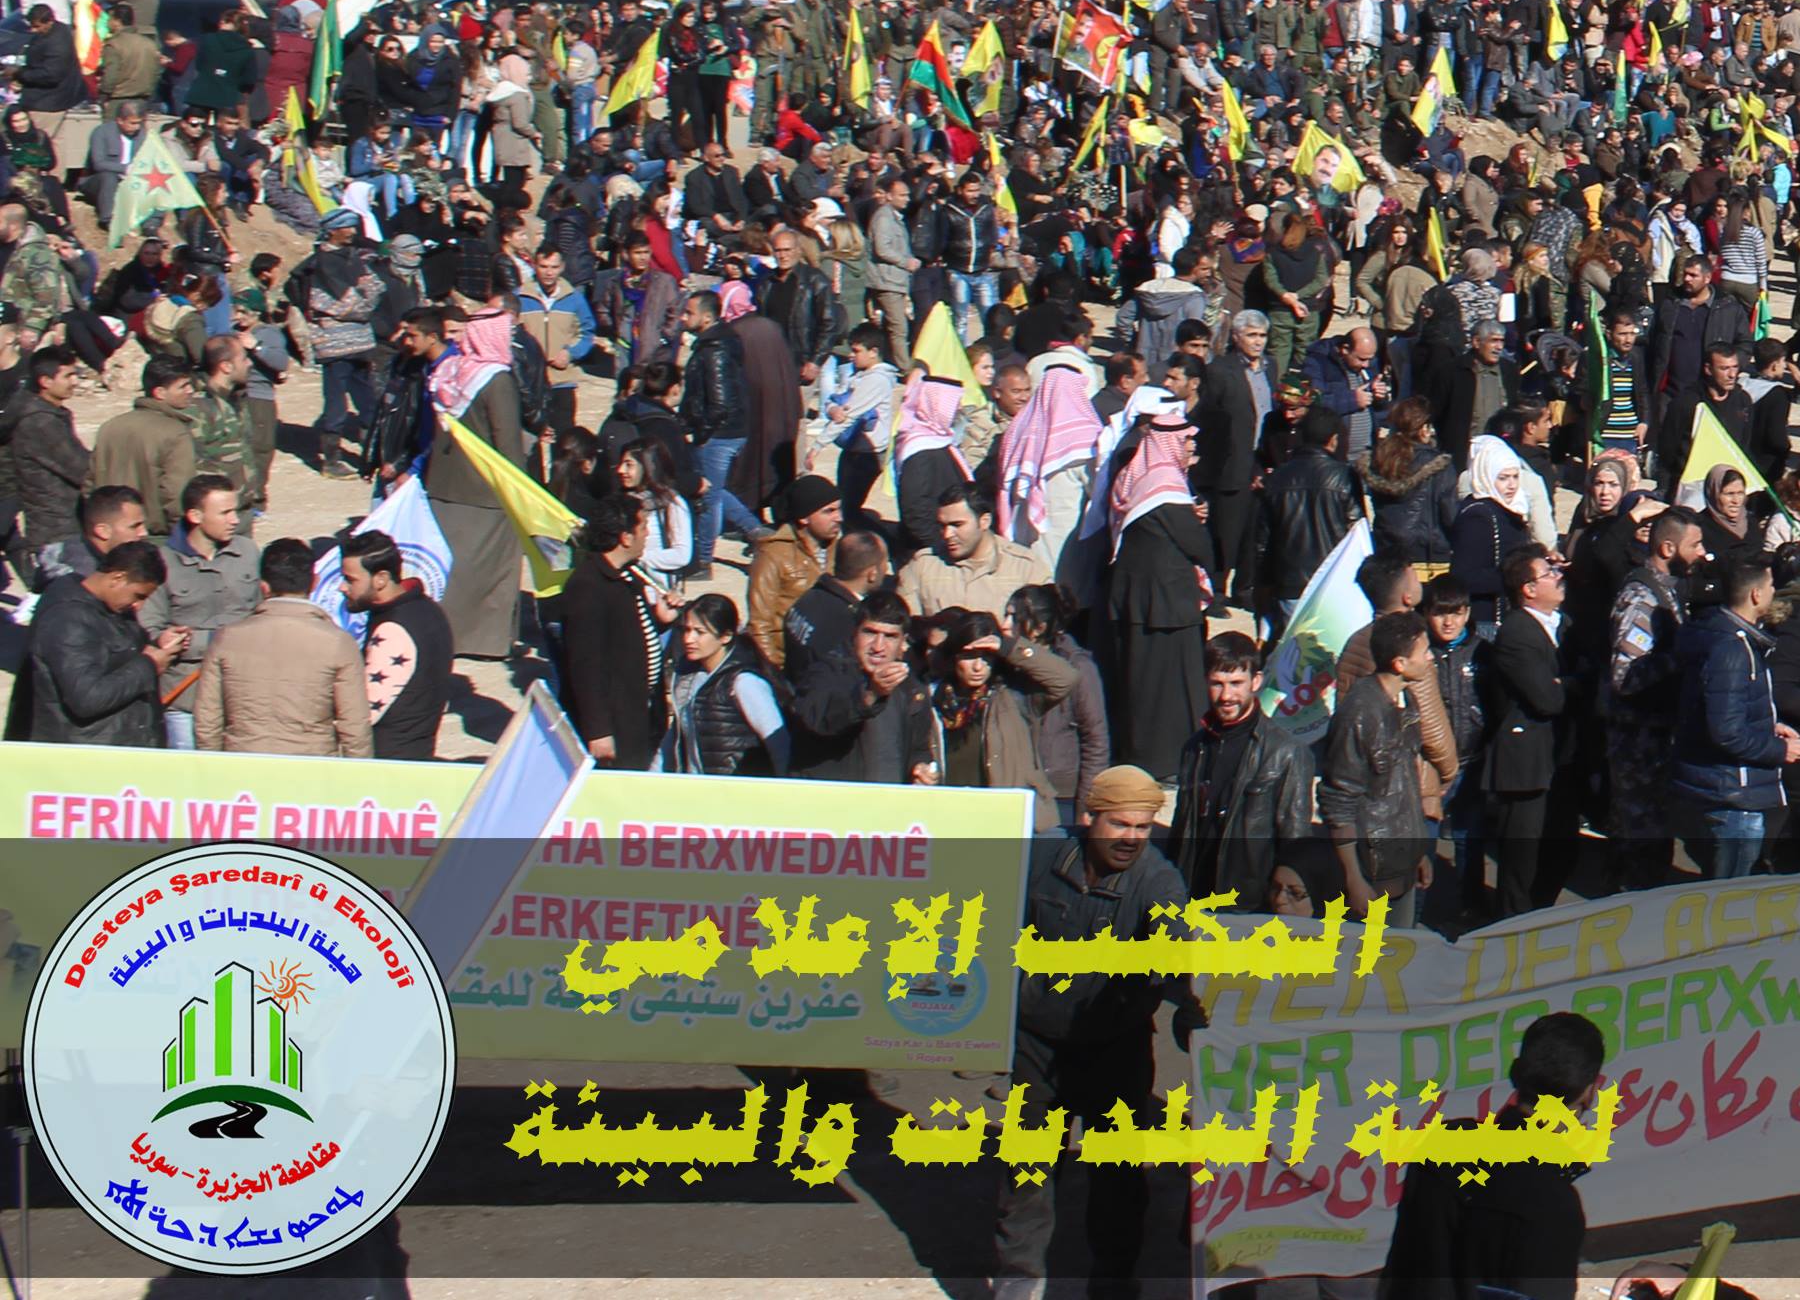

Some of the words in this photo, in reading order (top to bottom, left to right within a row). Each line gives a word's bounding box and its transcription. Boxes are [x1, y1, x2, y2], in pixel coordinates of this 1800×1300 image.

[30, 788, 171, 844] EFRÎN
[190, 794, 258, 843] WÊ
[275, 800, 438, 856] BIMÎNÊ
[620, 825, 928, 879] BERXWEDANÊ
[629, 975, 742, 1025] ستبقى
[749, 980, 861, 1030] عفرين
[1200, 1031, 1354, 1113] HER
[1643, 1030, 1776, 1147] مكان
